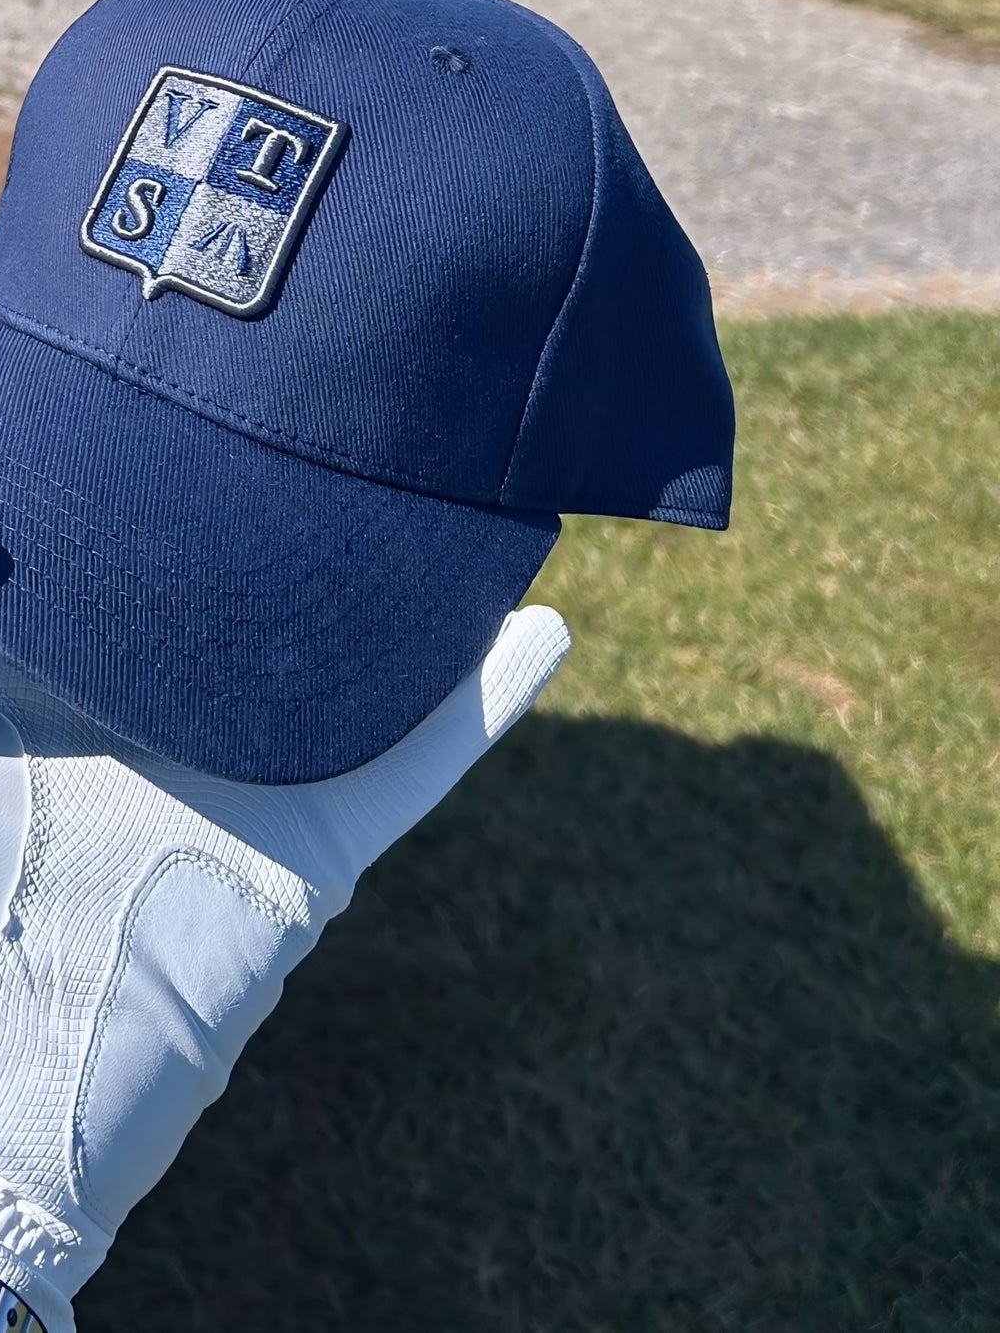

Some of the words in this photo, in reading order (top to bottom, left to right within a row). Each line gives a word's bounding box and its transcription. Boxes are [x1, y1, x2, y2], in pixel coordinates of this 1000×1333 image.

[165, 90, 219, 147] V
[235, 117, 310, 191] T
[111, 177, 165, 241] S
